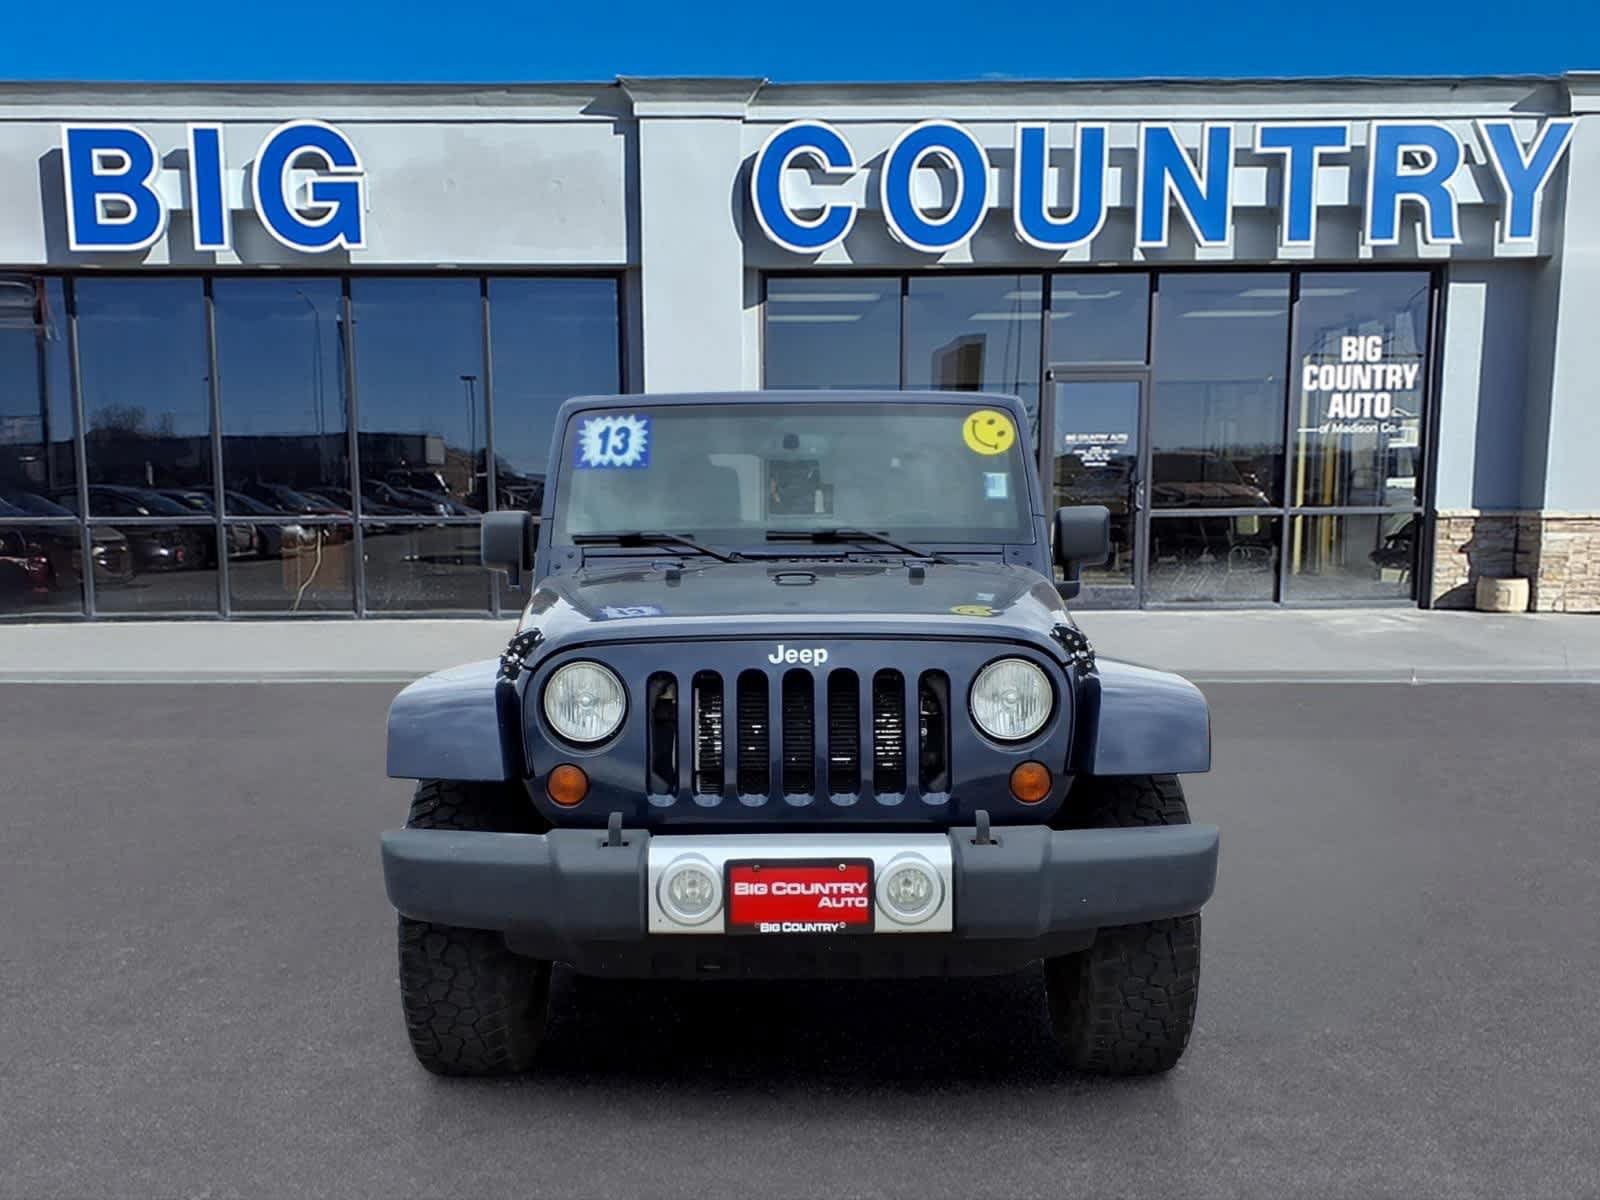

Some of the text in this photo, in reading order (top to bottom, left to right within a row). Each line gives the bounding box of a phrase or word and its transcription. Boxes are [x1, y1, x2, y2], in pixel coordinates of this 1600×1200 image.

[61, 118, 1575, 254] BIG COUNTRY
[1341, 335, 1382, 362] BIG
[1303, 364, 1419, 391] COUNTRY
[1327, 392, 1391, 419] AUTO
[1331, 421, 1378, 433] Madison
[598, 425, 631, 457] 13
[768, 644, 828, 667] Jeep
[734, 881, 867, 896] BIG COUNTRY
[817, 896, 868, 908] AUTO
[760, 922, 838, 933] BIG COUNTRY
